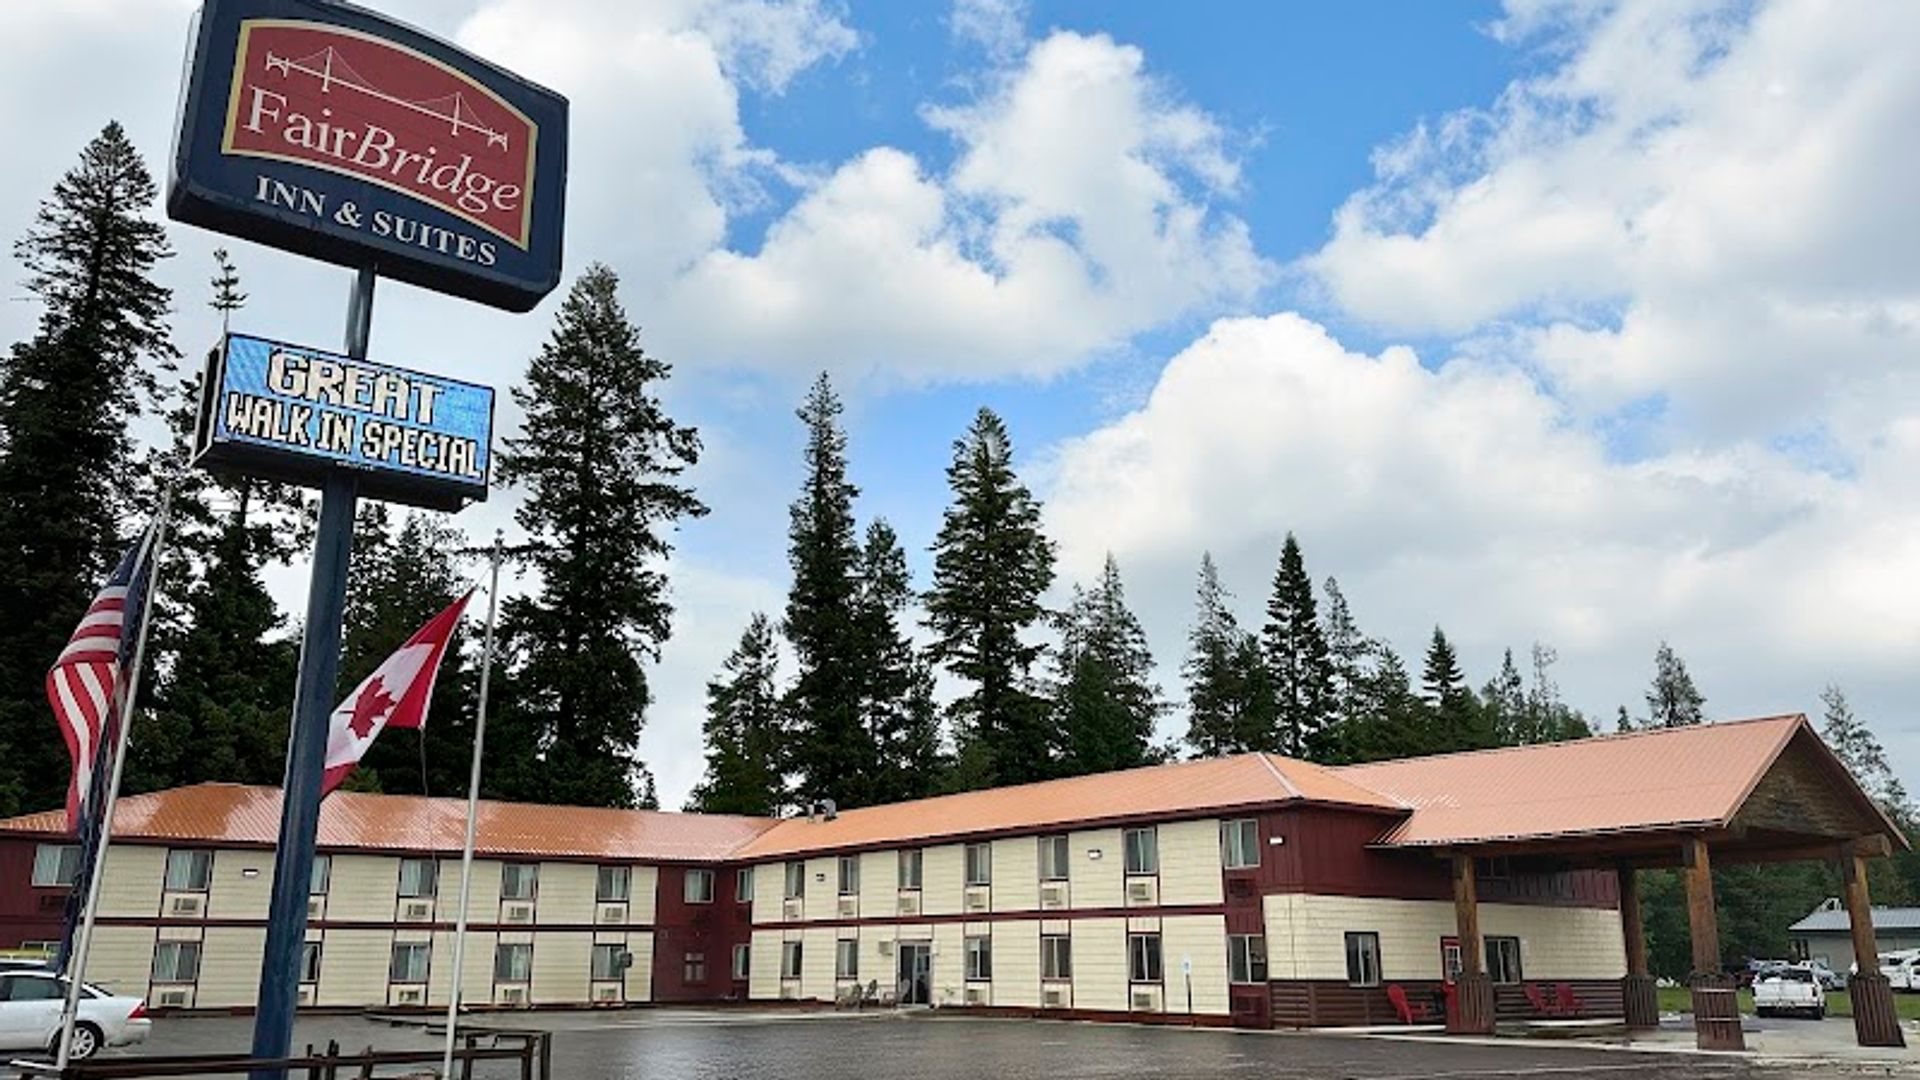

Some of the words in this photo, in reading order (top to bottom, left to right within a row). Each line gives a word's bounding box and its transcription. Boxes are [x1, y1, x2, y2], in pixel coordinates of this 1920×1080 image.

[243, 84, 520, 213] FairBridge
[257, 175, 326, 216] INN
[334, 200, 363, 227] &
[372, 211, 497, 265] SUITES
[269, 350, 443, 424] GREAT
[227, 393, 311, 444] WALK
[316, 410, 355, 454] IN
[363, 421, 482, 476] SPECIAL
